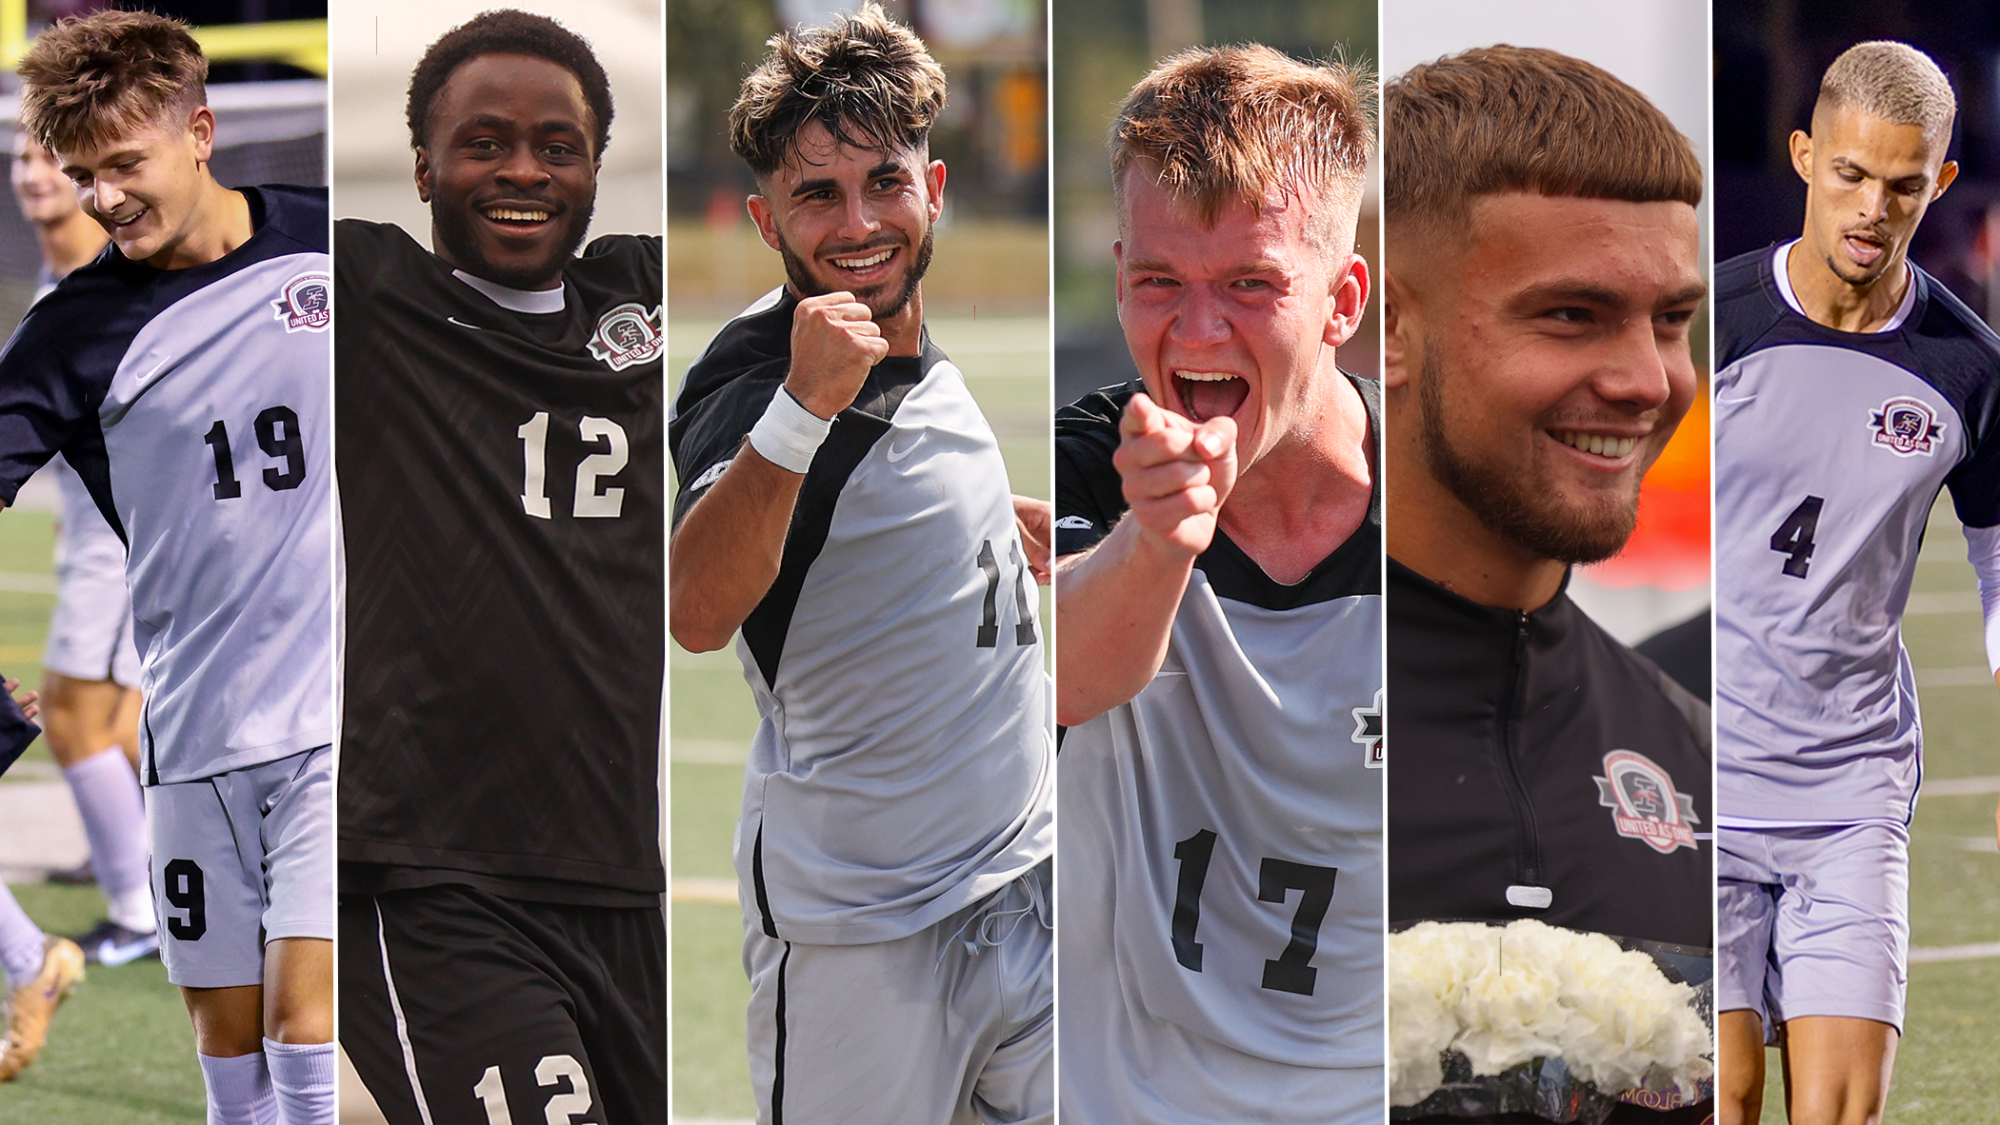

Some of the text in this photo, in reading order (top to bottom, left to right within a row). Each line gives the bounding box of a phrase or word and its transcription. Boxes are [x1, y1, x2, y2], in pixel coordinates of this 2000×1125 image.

[290, 311, 329, 327] UNITED AS
[612, 348, 642, 365] UNITED
[641, 342, 654, 353] AS
[203, 405, 306, 501] 19
[517, 411, 629, 519] 12
[1877, 433, 1904, 446] UNITED
[1904, 438, 1915, 448] AS
[1770, 494, 1825, 580] 4
[975, 539, 1038, 648] 11
[1618, 817, 1658, 836] UNITED
[1658, 822, 1674, 839] AS
[1170, 828, 1338, 996] 17
[473, 1054, 593, 1125] 12
